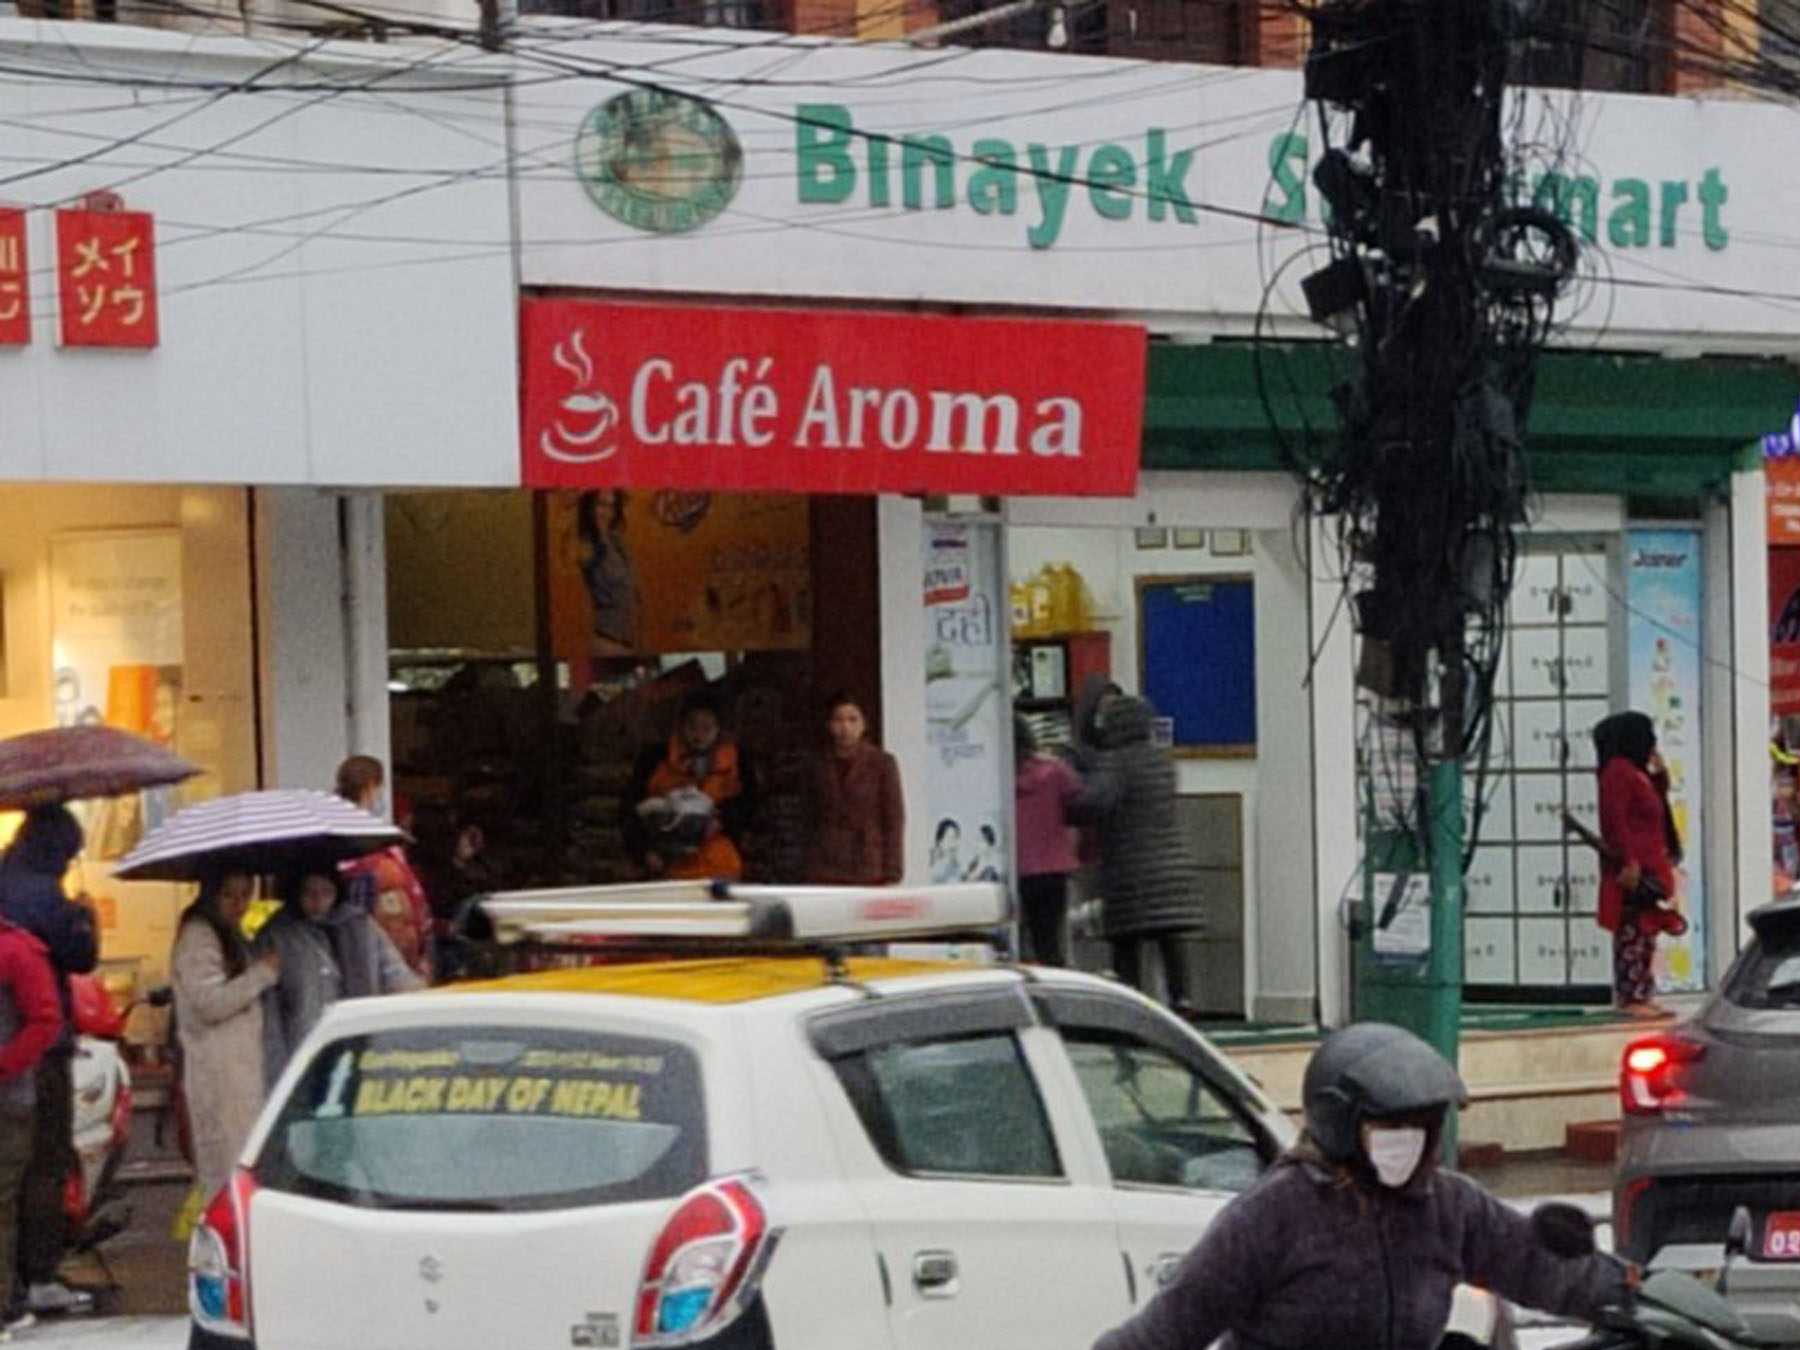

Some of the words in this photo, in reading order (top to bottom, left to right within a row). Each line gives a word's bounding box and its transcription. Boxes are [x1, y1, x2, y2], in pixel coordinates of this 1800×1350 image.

[795, 103, 1198, 250] Binayek
[630, 356, 779, 448] Café
[793, 364, 1084, 458] Aroma
[354, 1076, 445, 1116] BLACK
[446, 1076, 506, 1113] DAY
[551, 1080, 642, 1120] NEPAL
